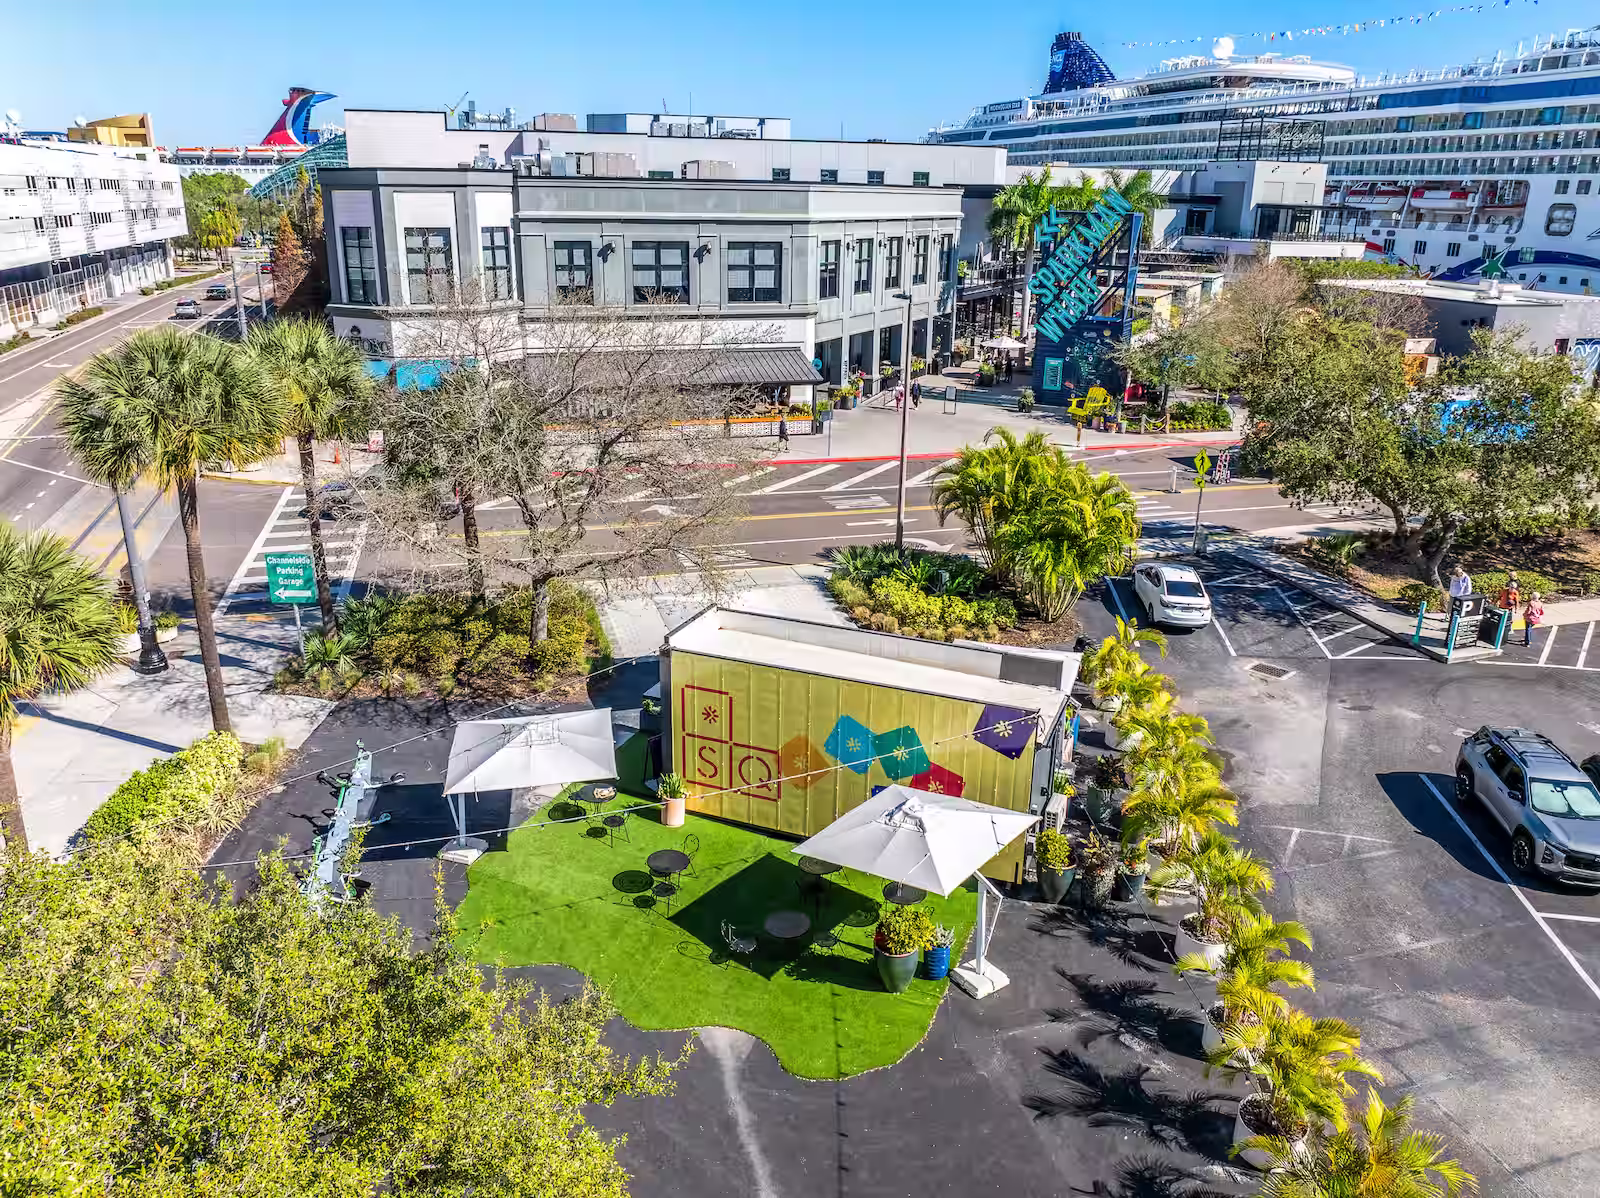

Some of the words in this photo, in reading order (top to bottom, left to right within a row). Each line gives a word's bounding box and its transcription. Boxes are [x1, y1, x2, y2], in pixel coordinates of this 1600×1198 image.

[1028, 187, 1132, 305] SPARKMAN
[1034, 267, 1102, 344] WHARF
[266, 556, 311, 565] Channelside
[276, 566, 304, 577] Parking
[278, 577, 304, 587] Garage
[1461, 600, 1475, 617] P
